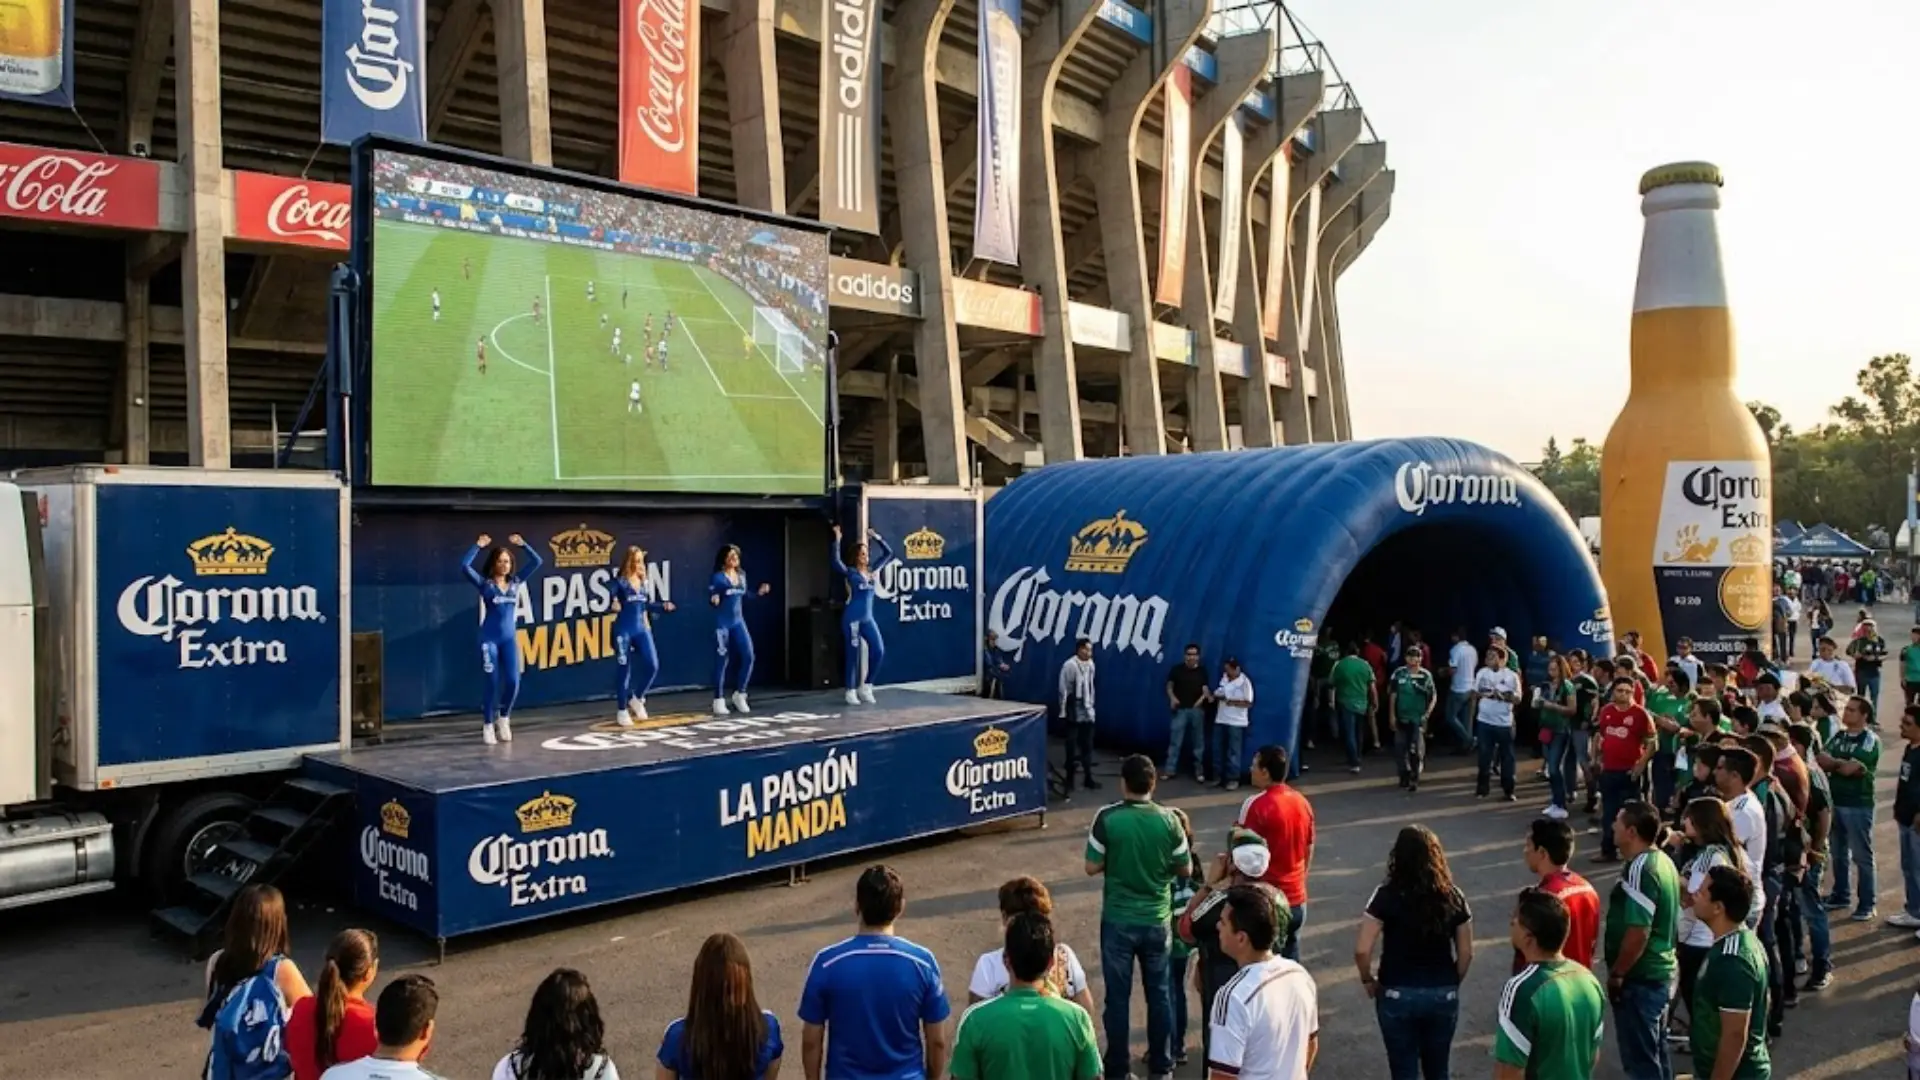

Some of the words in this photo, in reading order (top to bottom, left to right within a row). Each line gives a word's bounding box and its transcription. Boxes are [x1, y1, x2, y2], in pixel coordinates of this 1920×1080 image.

[267, 184, 351, 243] Coca
[837, 272, 913, 304] adidas
[1395, 461, 1519, 516] Corona
[543, 560, 671, 622] PASN
[873, 557, 969, 603] Corona
[117, 573, 322, 643] Corona
[899, 594, 952, 622] Extra
[988, 565, 1170, 663] Corona
[177, 628, 288, 669] Extra
[720, 781, 757, 827] LA
[762, 747, 859, 814] PASIÓN
[946, 755, 1029, 799] Corona
[970, 788, 1016, 814] Extra
[360, 824, 430, 881] Corona
[746, 794, 847, 859] MANDA
[467, 827, 612, 887] Corona
[378, 868, 418, 911] Extra
[509, 871, 588, 907] Extra
